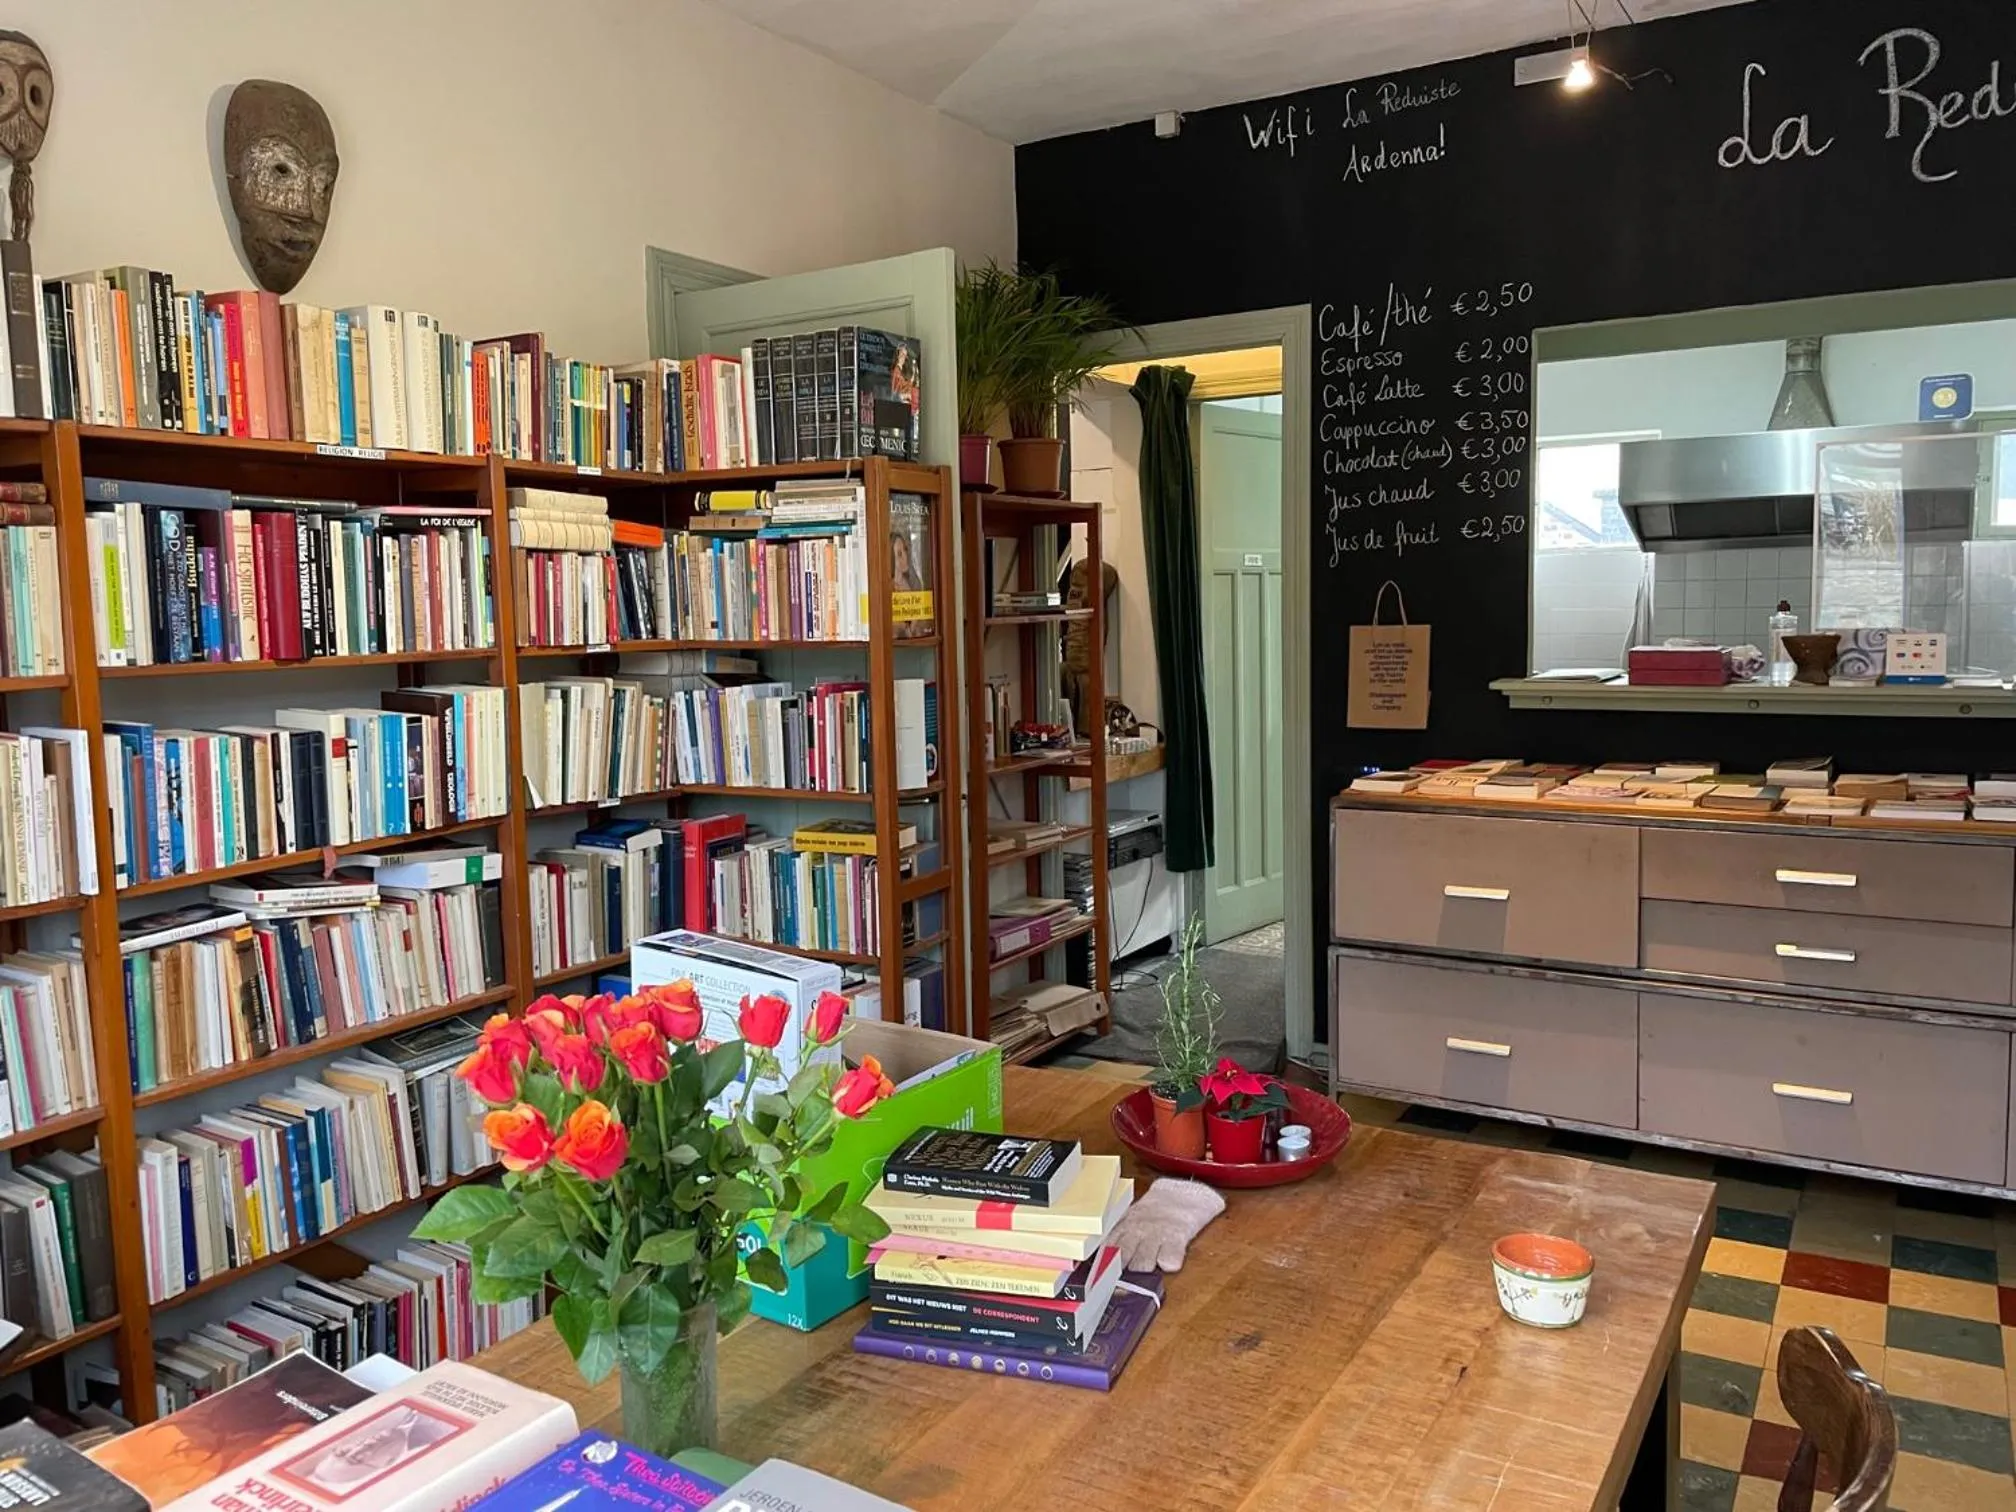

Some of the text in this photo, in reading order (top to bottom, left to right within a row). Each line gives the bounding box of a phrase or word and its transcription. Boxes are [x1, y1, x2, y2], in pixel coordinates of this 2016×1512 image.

[1243, 78, 1462, 157] Wifi La Reduiste
[1718, 27, 2016, 183] La Red
[1320, 347, 1403, 377] Espresso
[1323, 382, 1368, 416] Café
[1374, 374, 1425, 402] Latte
[1319, 413, 1436, 450] Cappuccino
[1324, 485, 1362, 523] Jus
[1368, 477, 1435, 506] chaud
[1325, 523, 1360, 568] Jus
[1364, 529, 1384, 550] de
[1395, 519, 1440, 557] fruit
[705, 975, 750, 994] COLLECTION
[886, 1294, 968, 1312] DIT WAS HET NIEUWS NIET
[972, 1307, 1040, 1323] DE CORRESPONDENT
